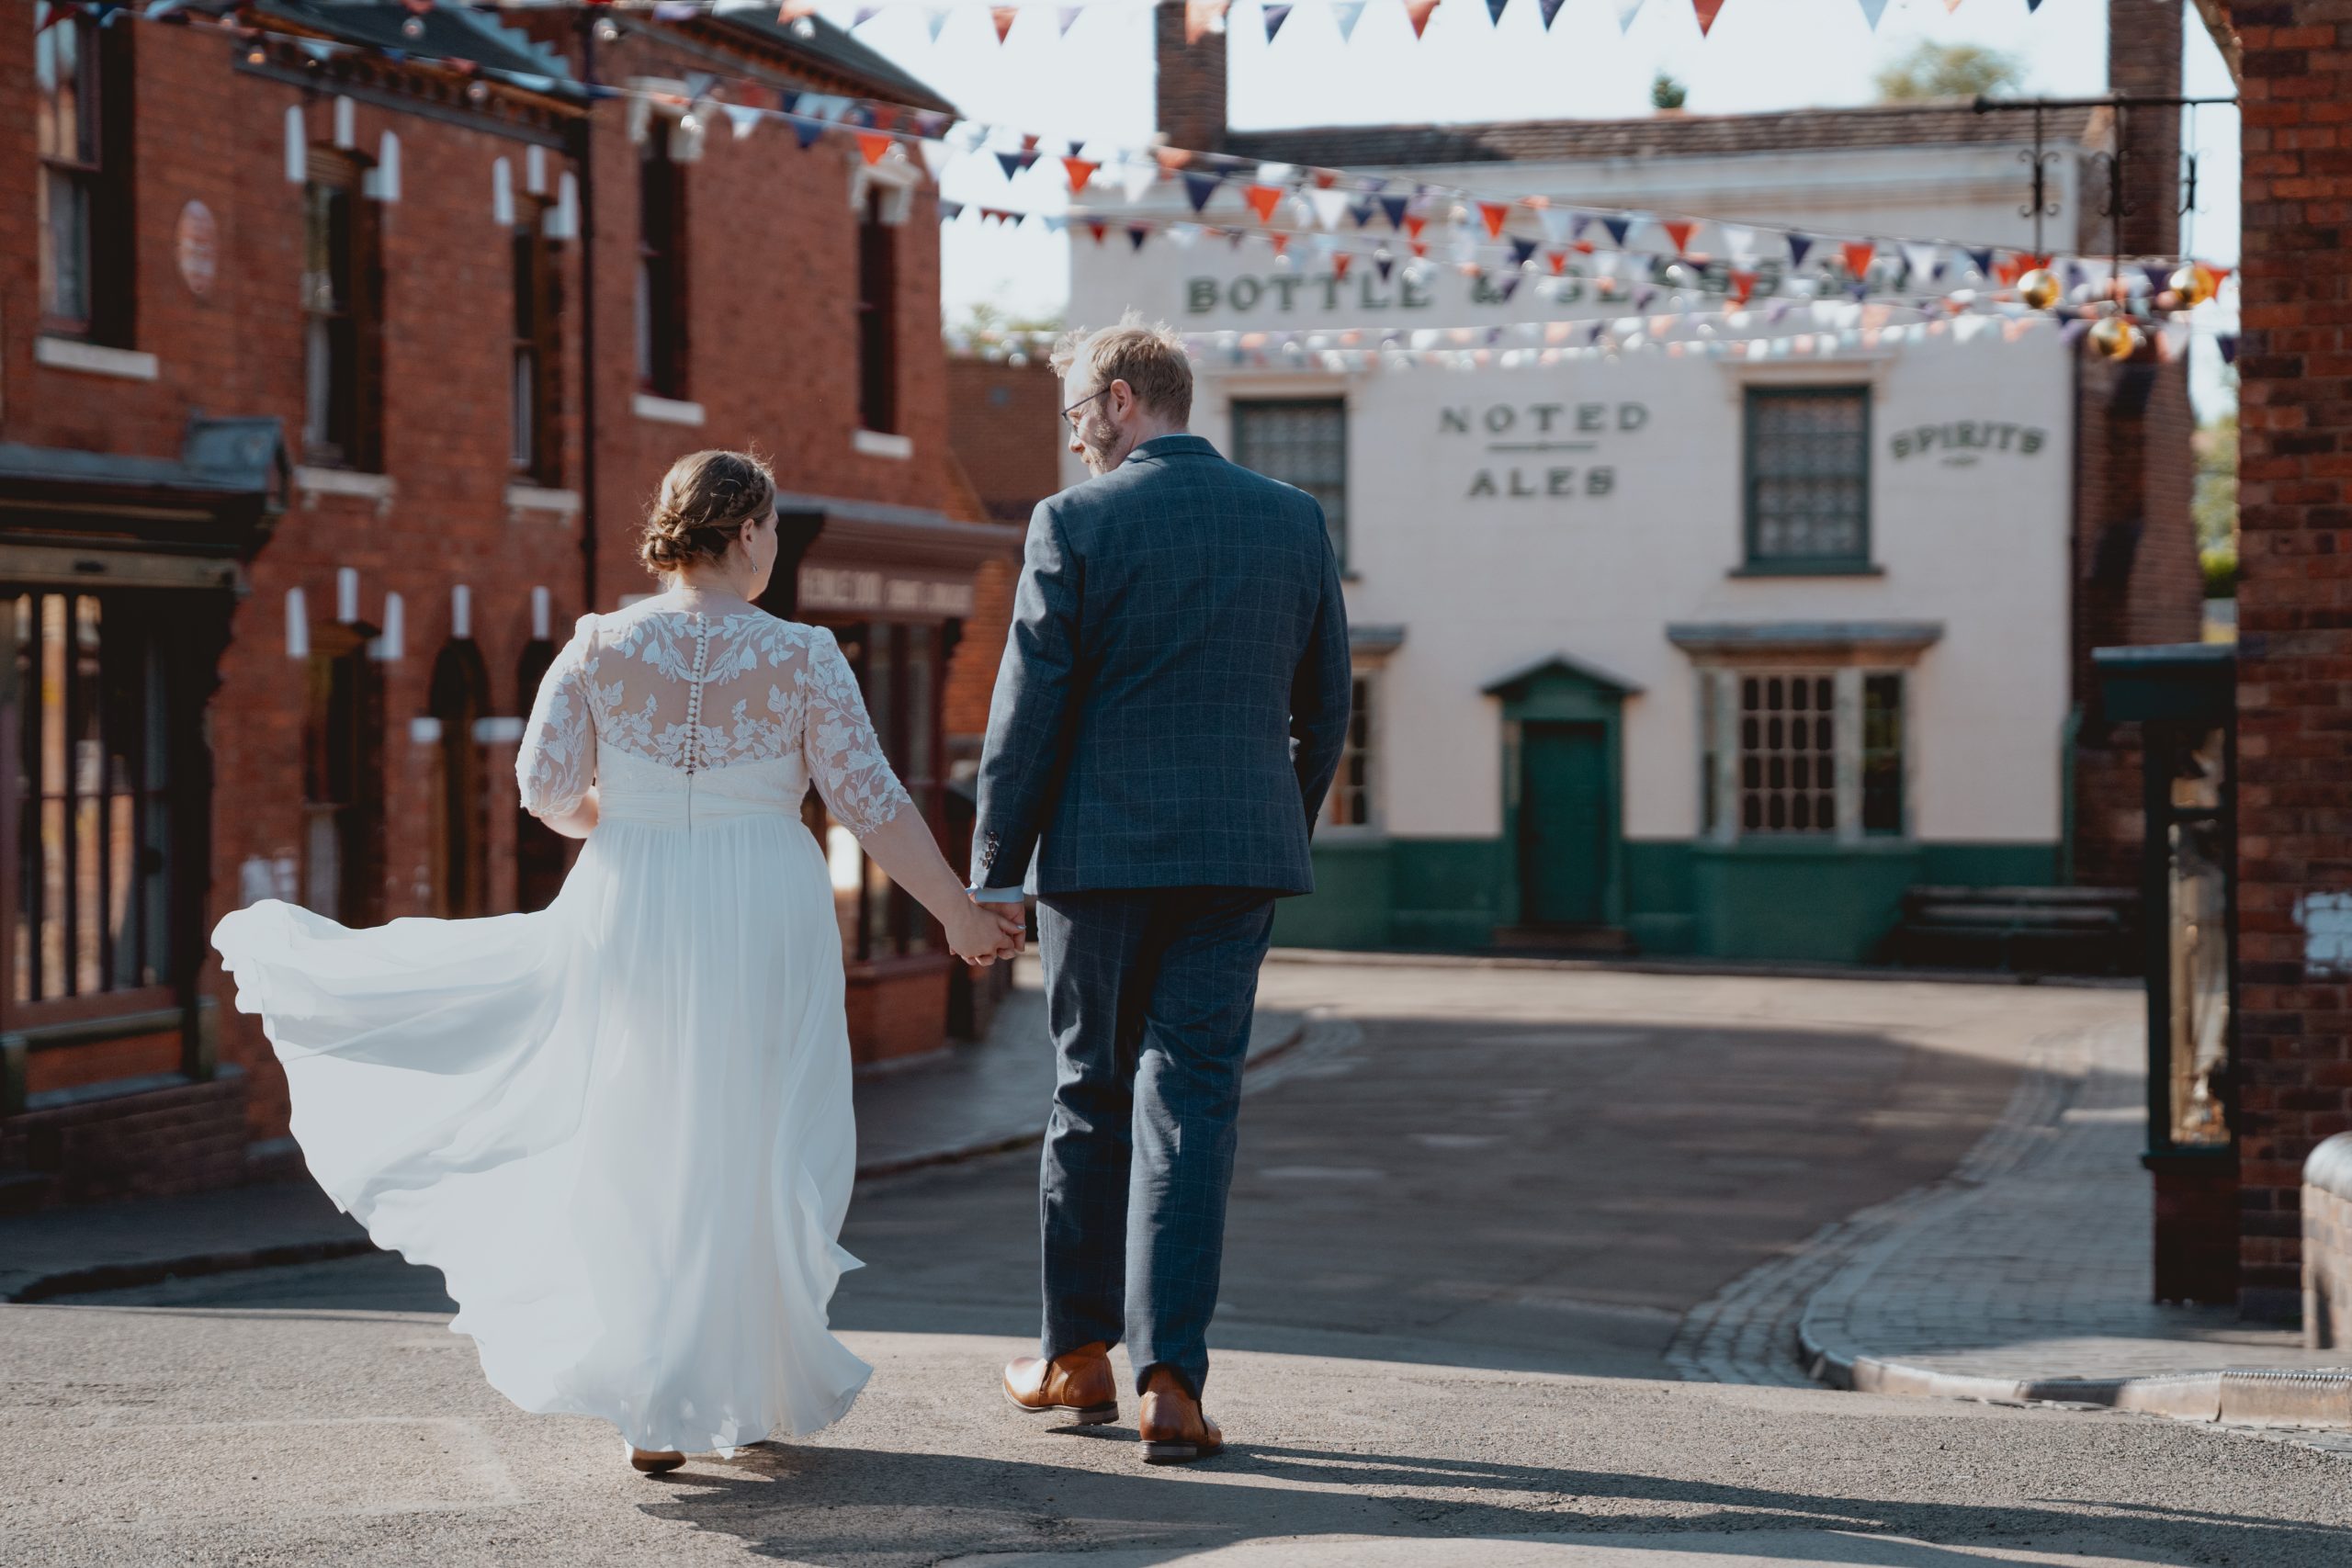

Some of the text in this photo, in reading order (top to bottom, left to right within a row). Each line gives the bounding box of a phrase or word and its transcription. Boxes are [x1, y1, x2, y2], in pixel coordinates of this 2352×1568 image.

[1186, 272, 1433, 312] BOTTLE
[1438, 401, 1651, 434] NOTED
[1890, 419, 2049, 459] SPIRITS
[1468, 465, 1616, 497] ALES
